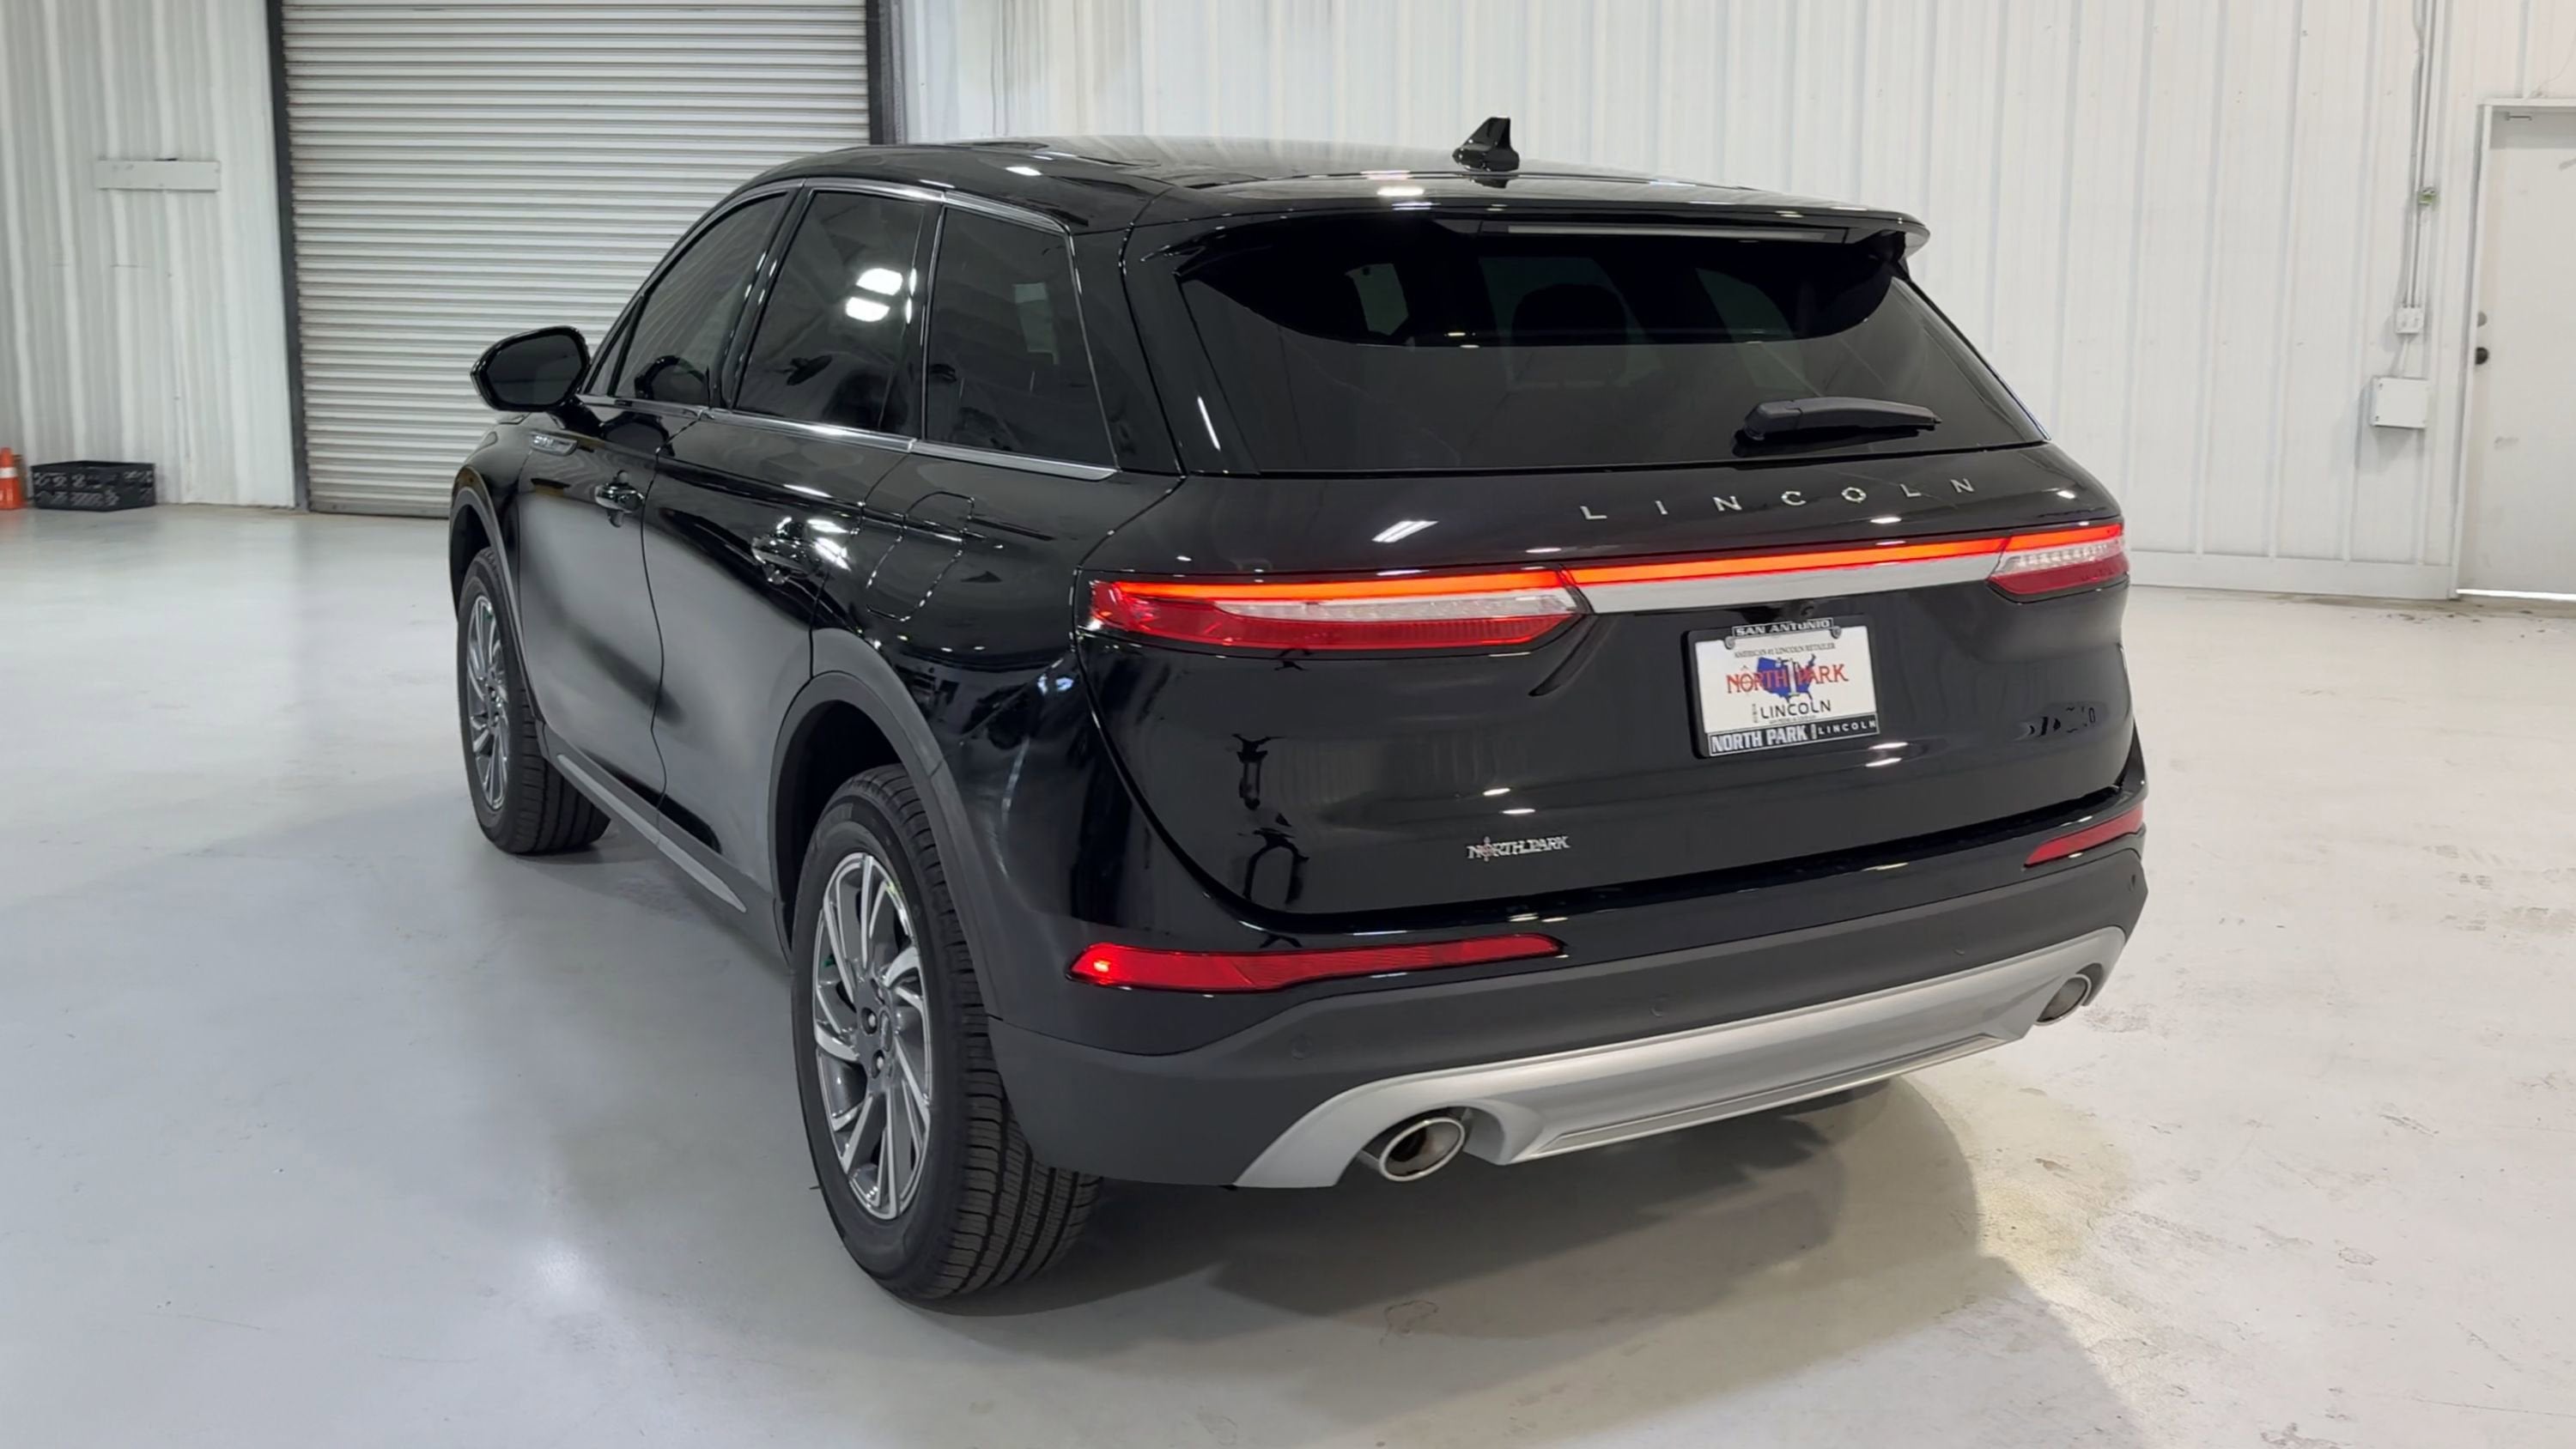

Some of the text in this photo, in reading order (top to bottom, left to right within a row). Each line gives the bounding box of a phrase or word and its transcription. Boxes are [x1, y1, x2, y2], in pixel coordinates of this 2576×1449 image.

[1580, 477, 1975, 521] LINCOLN
[1735, 619, 1831, 637] SAN ANTONIO
[1726, 664, 1850, 694] NORTH PARK
[1760, 700, 1832, 719] LINCOLN
[1711, 731, 1762, 753] NORTH
[1766, 724, 1807, 746] PARK
[1818, 719, 1876, 735] LINCOLN
